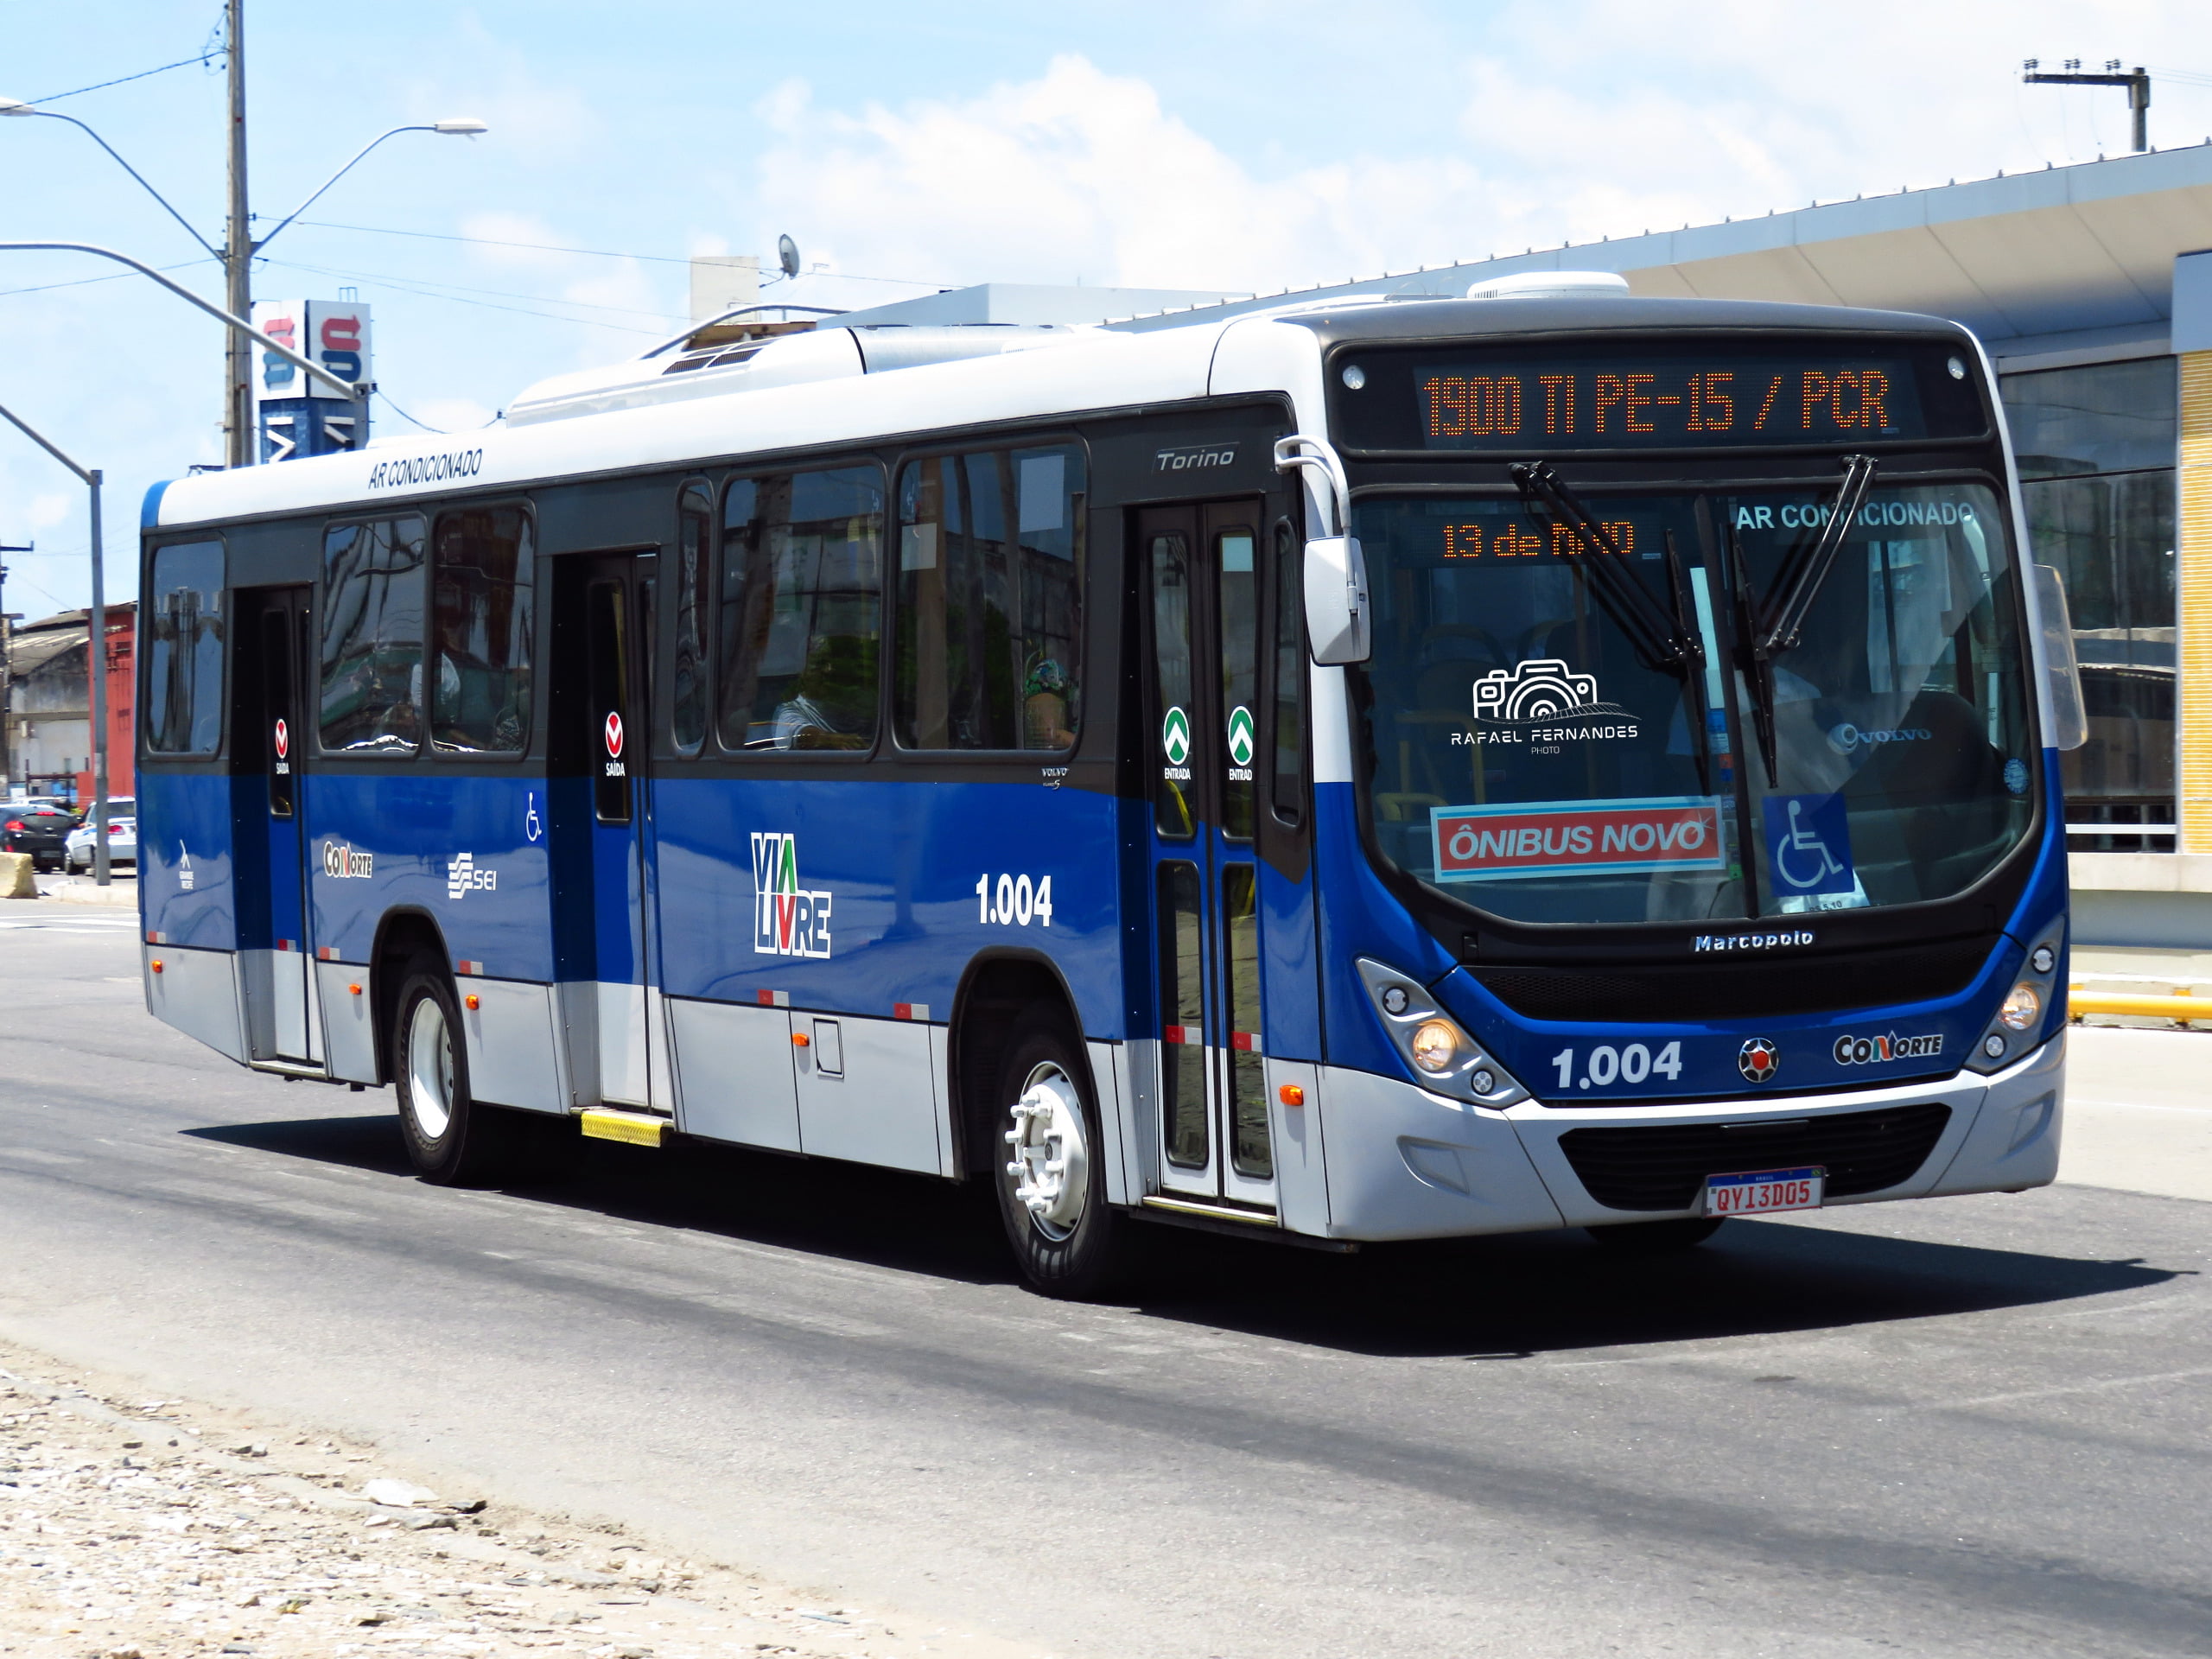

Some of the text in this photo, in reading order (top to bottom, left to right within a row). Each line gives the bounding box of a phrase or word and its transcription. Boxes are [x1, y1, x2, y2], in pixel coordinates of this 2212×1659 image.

[1424, 377, 1521, 435] 1900
[1538, 374, 1574, 434] TI
[1595, 372, 1733, 433] PE-15
[1802, 371, 1888, 429] PCR
[368, 448, 483, 489] AR CONDICIONADO
[1157, 449, 1235, 471] Torino
[1736, 502, 1974, 530] AR CONICIONADO
[1443, 524, 1483, 558] 13
[1493, 523, 1541, 557] de
[1857, 728, 1932, 744] VOLVO
[606, 760, 626, 777] SAÍDA
[1164, 767, 1192, 780] ENTRADA
[1449, 821, 1706, 861] ÔNIBUS NOVO
[473, 869, 497, 891] SEI
[751, 832, 798, 895] VIA
[976, 873, 1052, 927] 1.004
[754, 890, 832, 959] LIVRE
[1694, 930, 1814, 952] Marcopolo
[1552, 1041, 1682, 1090] 1.004
[1717, 1180, 1811, 1211] QYI3D05
